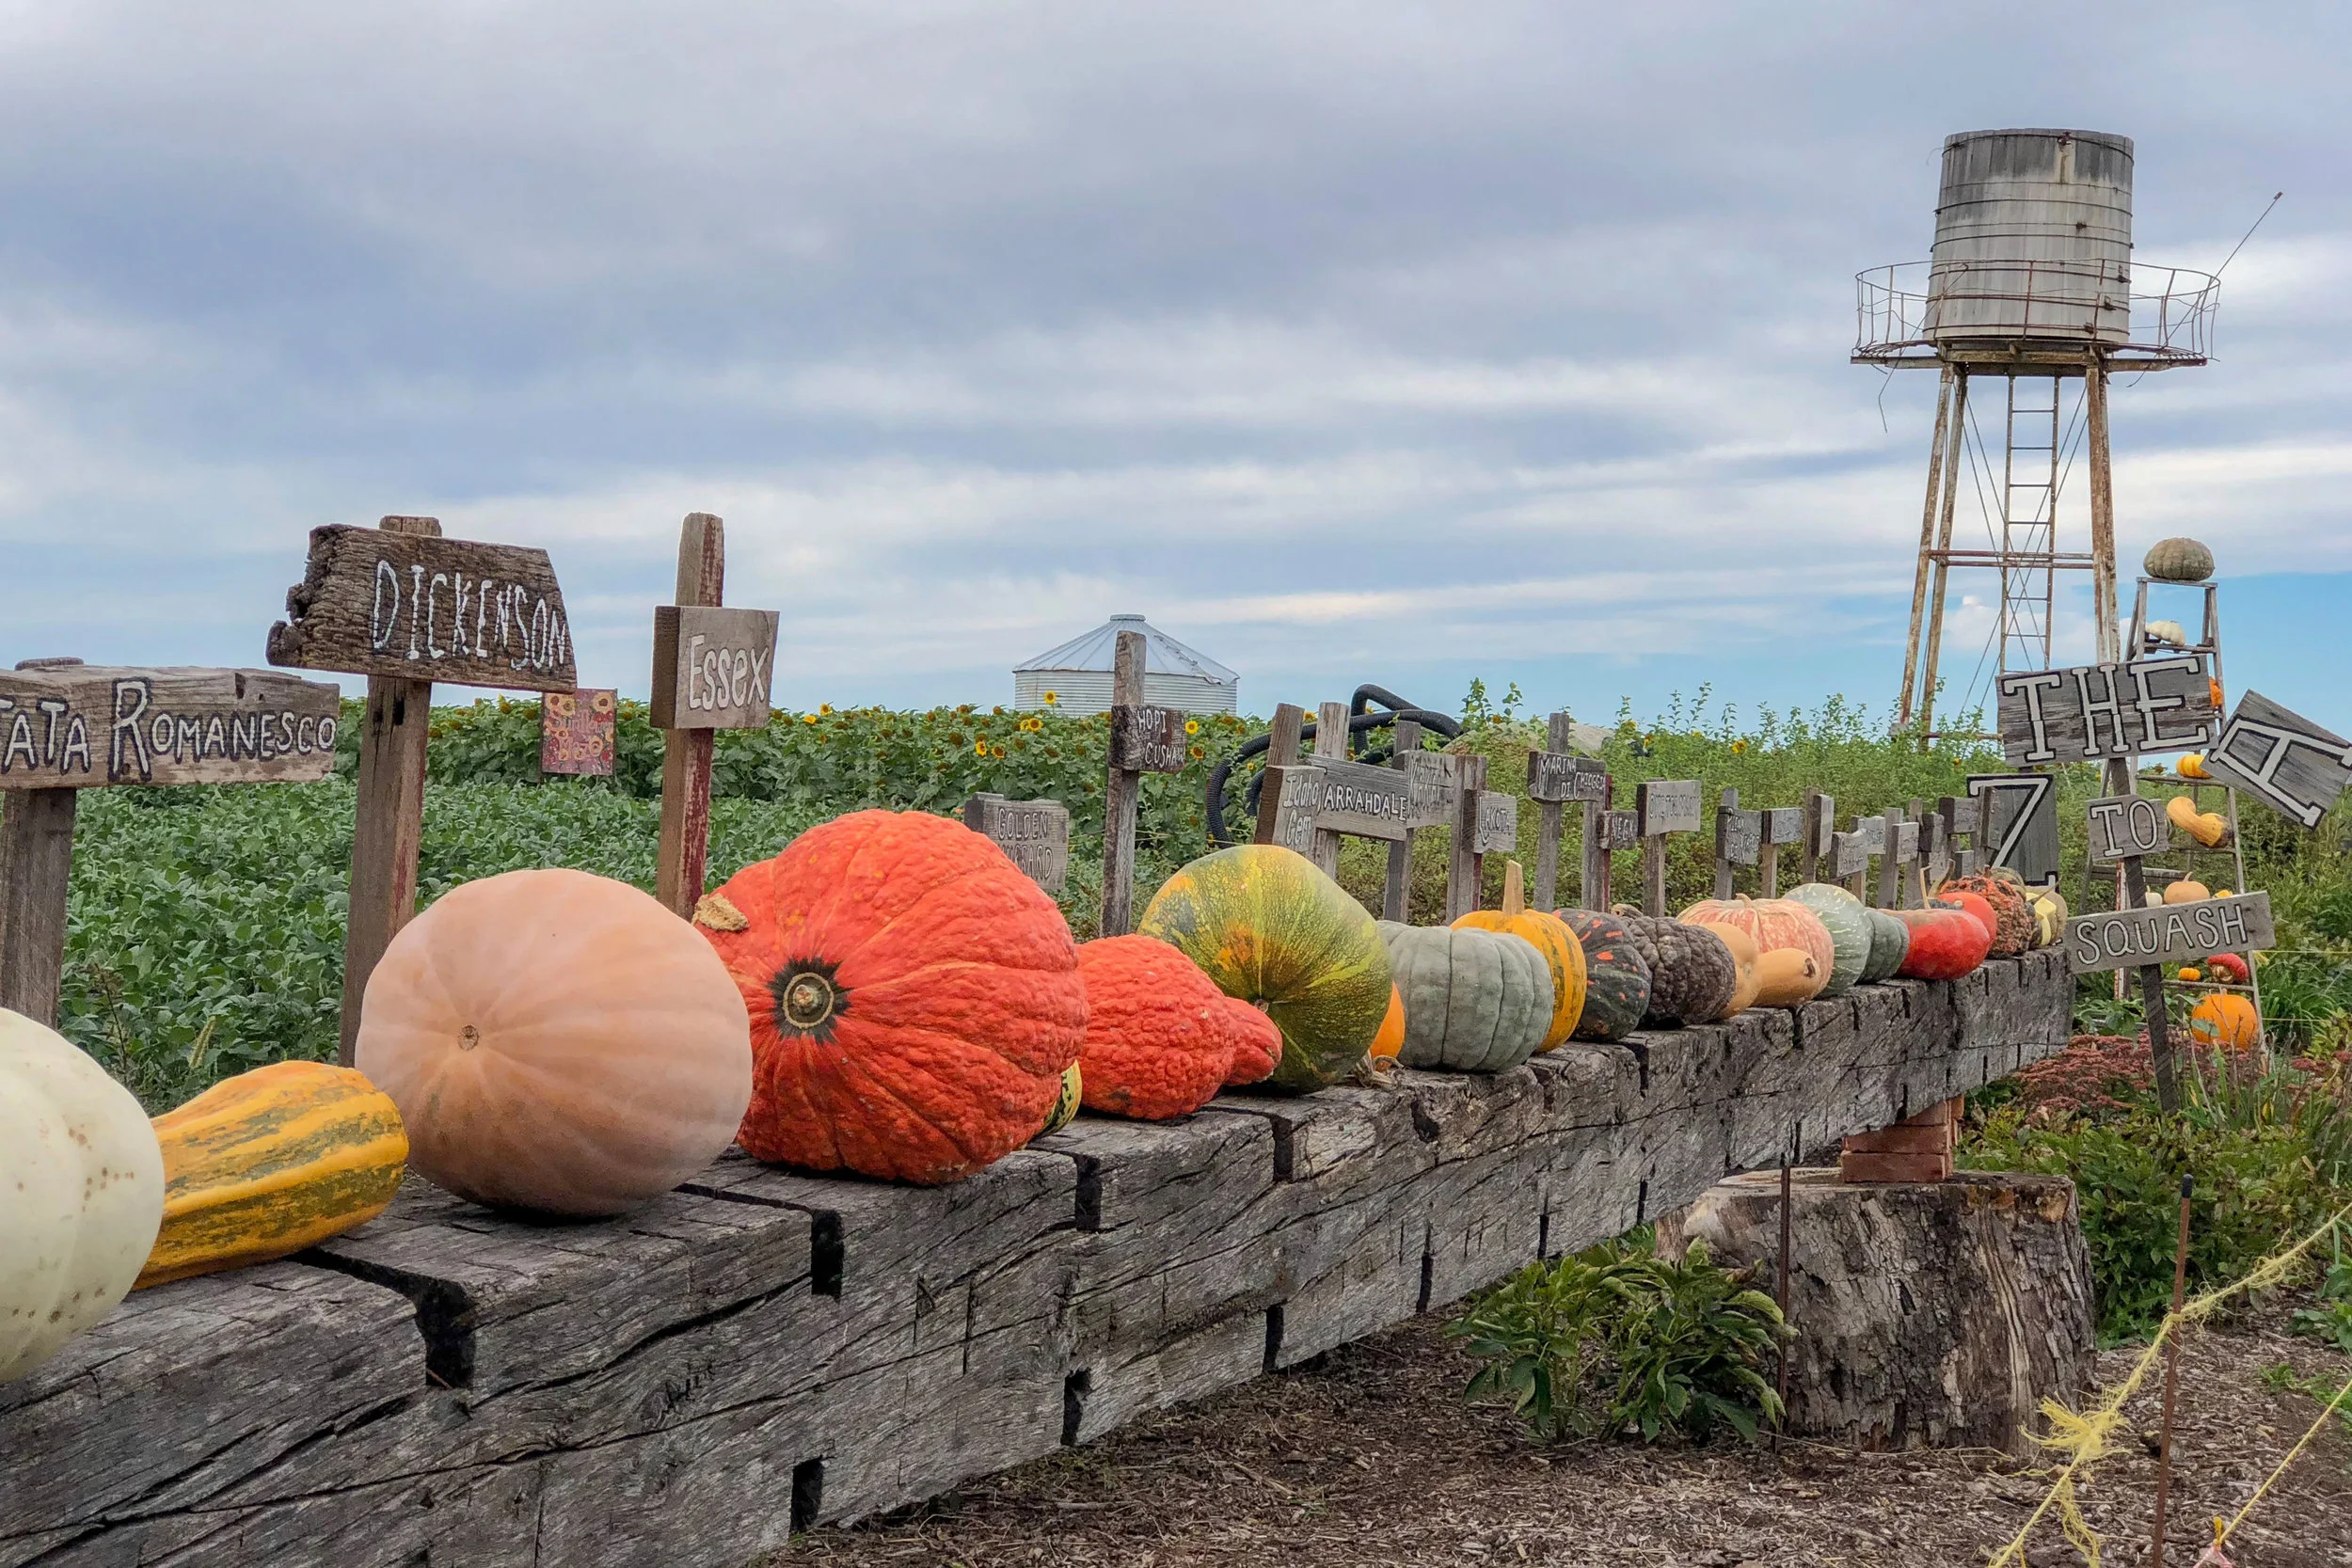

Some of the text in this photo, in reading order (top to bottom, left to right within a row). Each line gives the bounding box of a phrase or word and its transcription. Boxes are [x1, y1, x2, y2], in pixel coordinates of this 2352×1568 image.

[373, 560, 567, 672] DICKENSON
[0, 676, 337, 782] ATA ROMANESCO
[1136, 707, 1168, 733] HOPI
[2000, 655, 2210, 763] THE
[2210, 714, 2352, 832] A
[997, 806, 1049, 841] GOLDEN
[2090, 799, 2159, 858] TO
[2074, 902, 2249, 966] SQUASH
